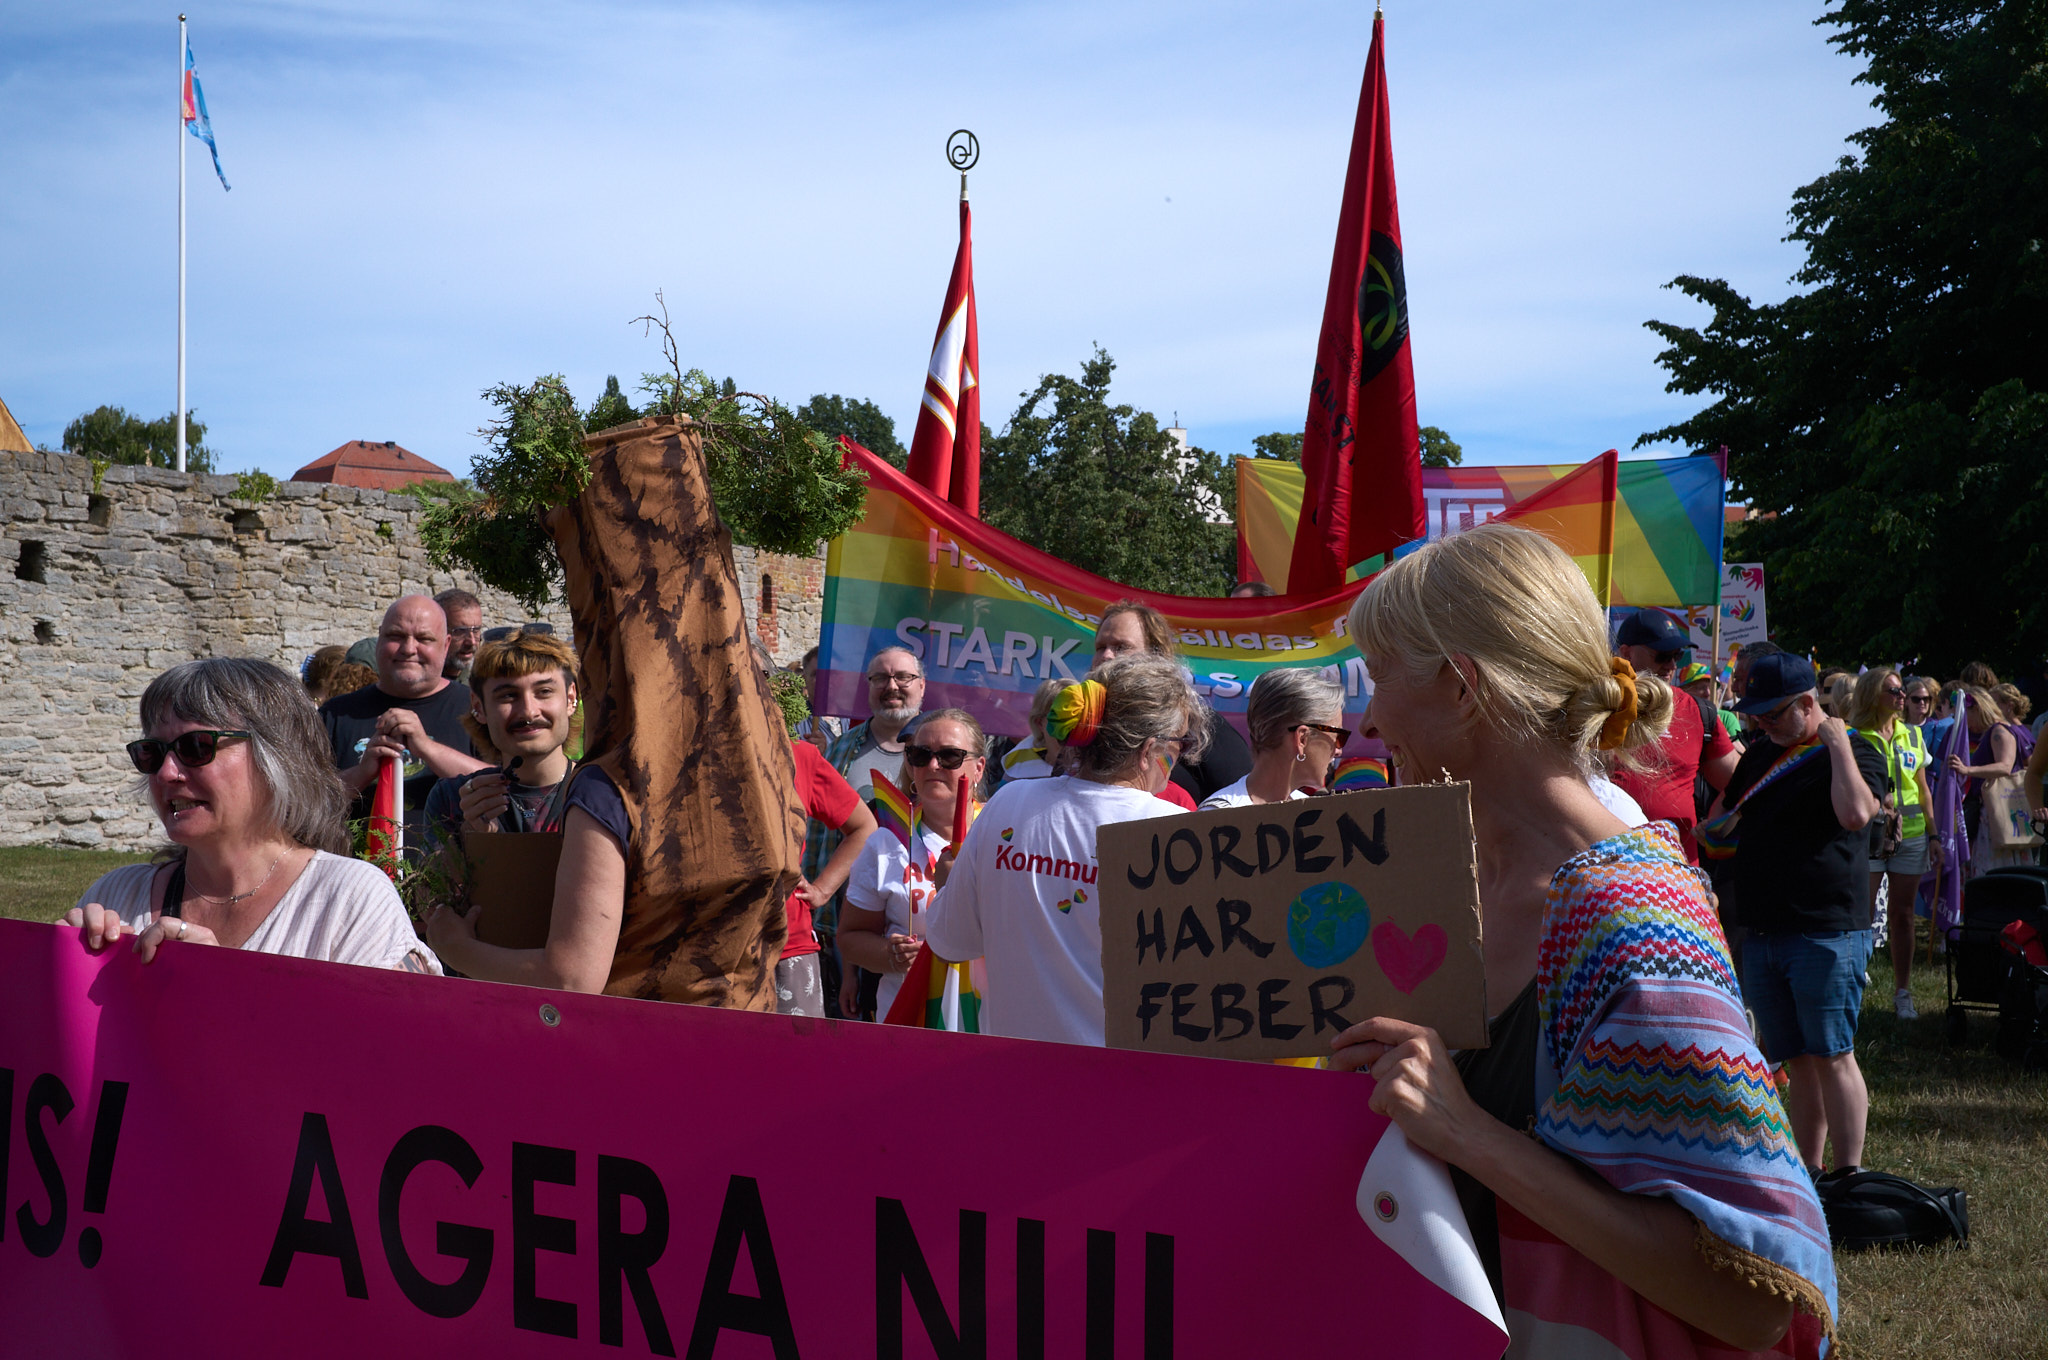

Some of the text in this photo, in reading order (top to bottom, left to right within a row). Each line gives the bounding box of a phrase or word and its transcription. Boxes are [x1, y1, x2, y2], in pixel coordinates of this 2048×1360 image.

[896, 617, 1081, 680] STARK
[995, 844, 1099, 885] Kommu
[1127, 807, 1390, 889] JORDEN
[1135, 898, 1275, 965] HAR
[1135, 976, 1356, 1042] FEBER
[259, 1111, 801, 1360] AGERA
